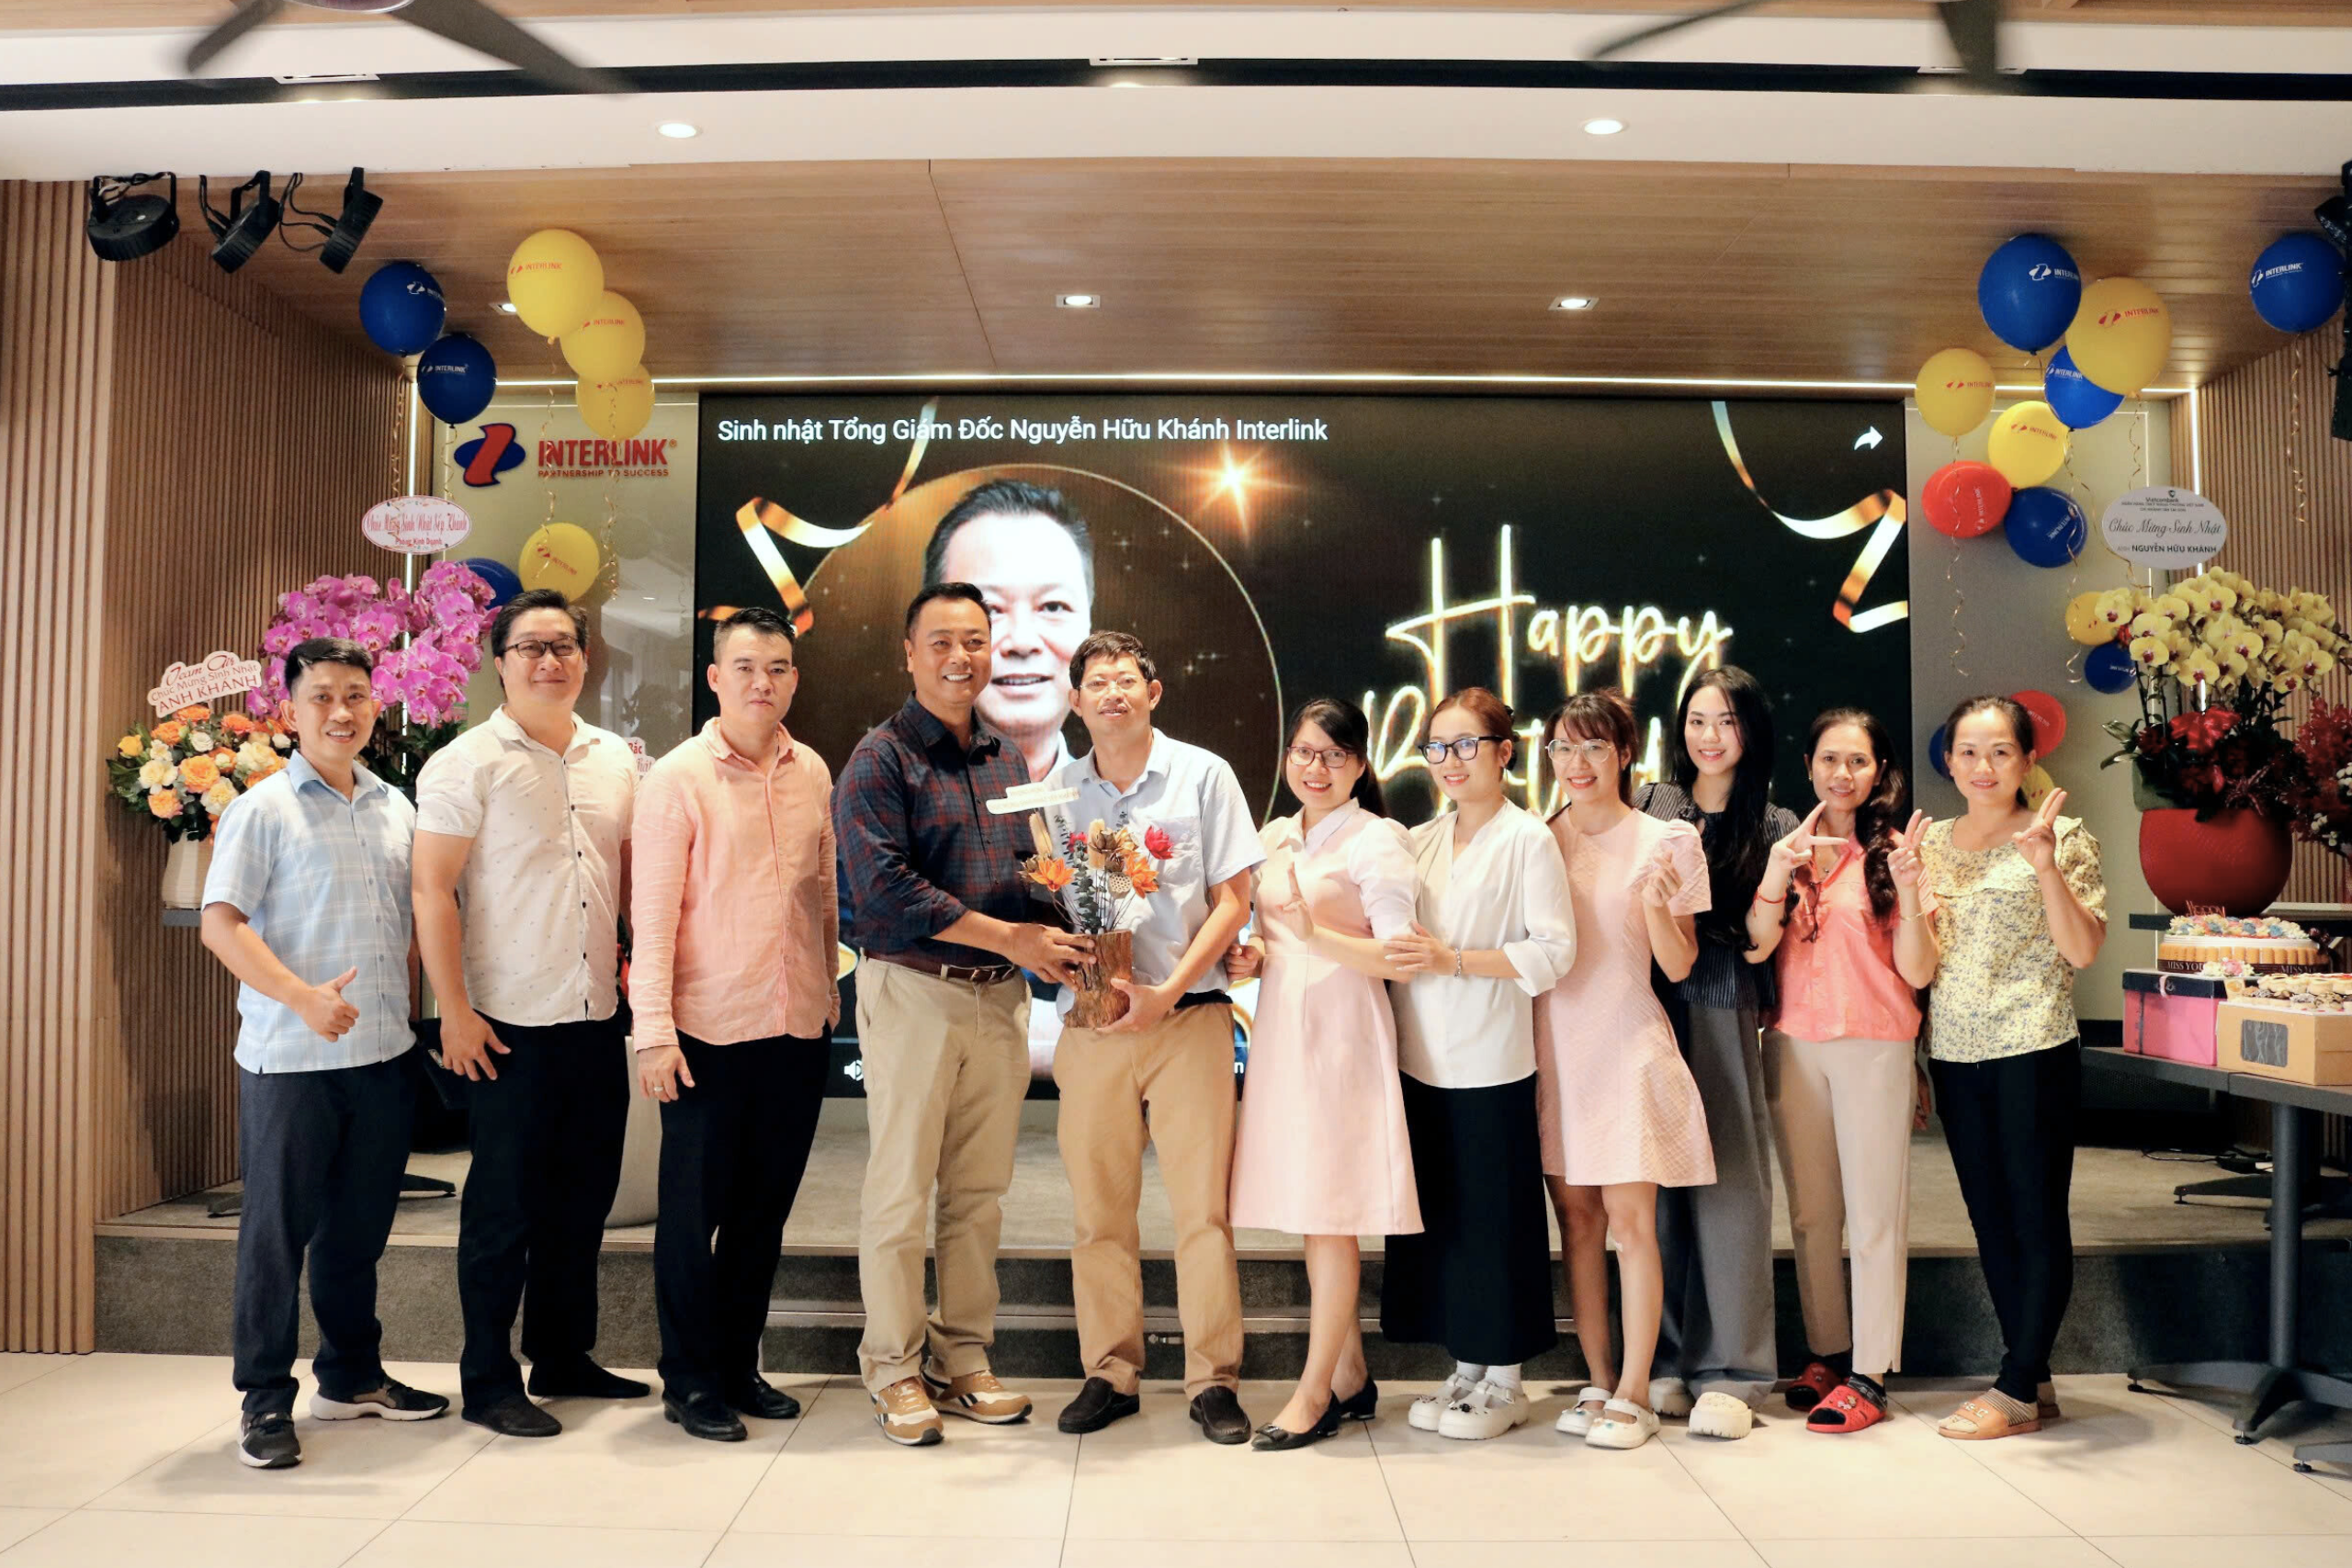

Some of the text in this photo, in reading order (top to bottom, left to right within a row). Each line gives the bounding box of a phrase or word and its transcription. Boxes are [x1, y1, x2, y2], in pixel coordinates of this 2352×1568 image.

[2124, 308, 2159, 318] INTERLINK
[718, 415, 1329, 445] Sinh nhật Tổng Giám Đốc Nguyễn Hữu Khánh Interlink
[2109, 518, 2222, 538] Chúc Mừng Sinh Nhật
[2132, 543, 2165, 552] NGUYỄN
[2166, 544, 2185, 552] HỮU
[2187, 544, 2216, 553] KHÁNH
[1385, 524, 1734, 709] Happy
[151, 686, 175, 701] Chúc
[209, 670, 231, 681] Sinh
[160, 675, 257, 713] ANH KHÁNH
[2168, 961, 2184, 970] MISS
